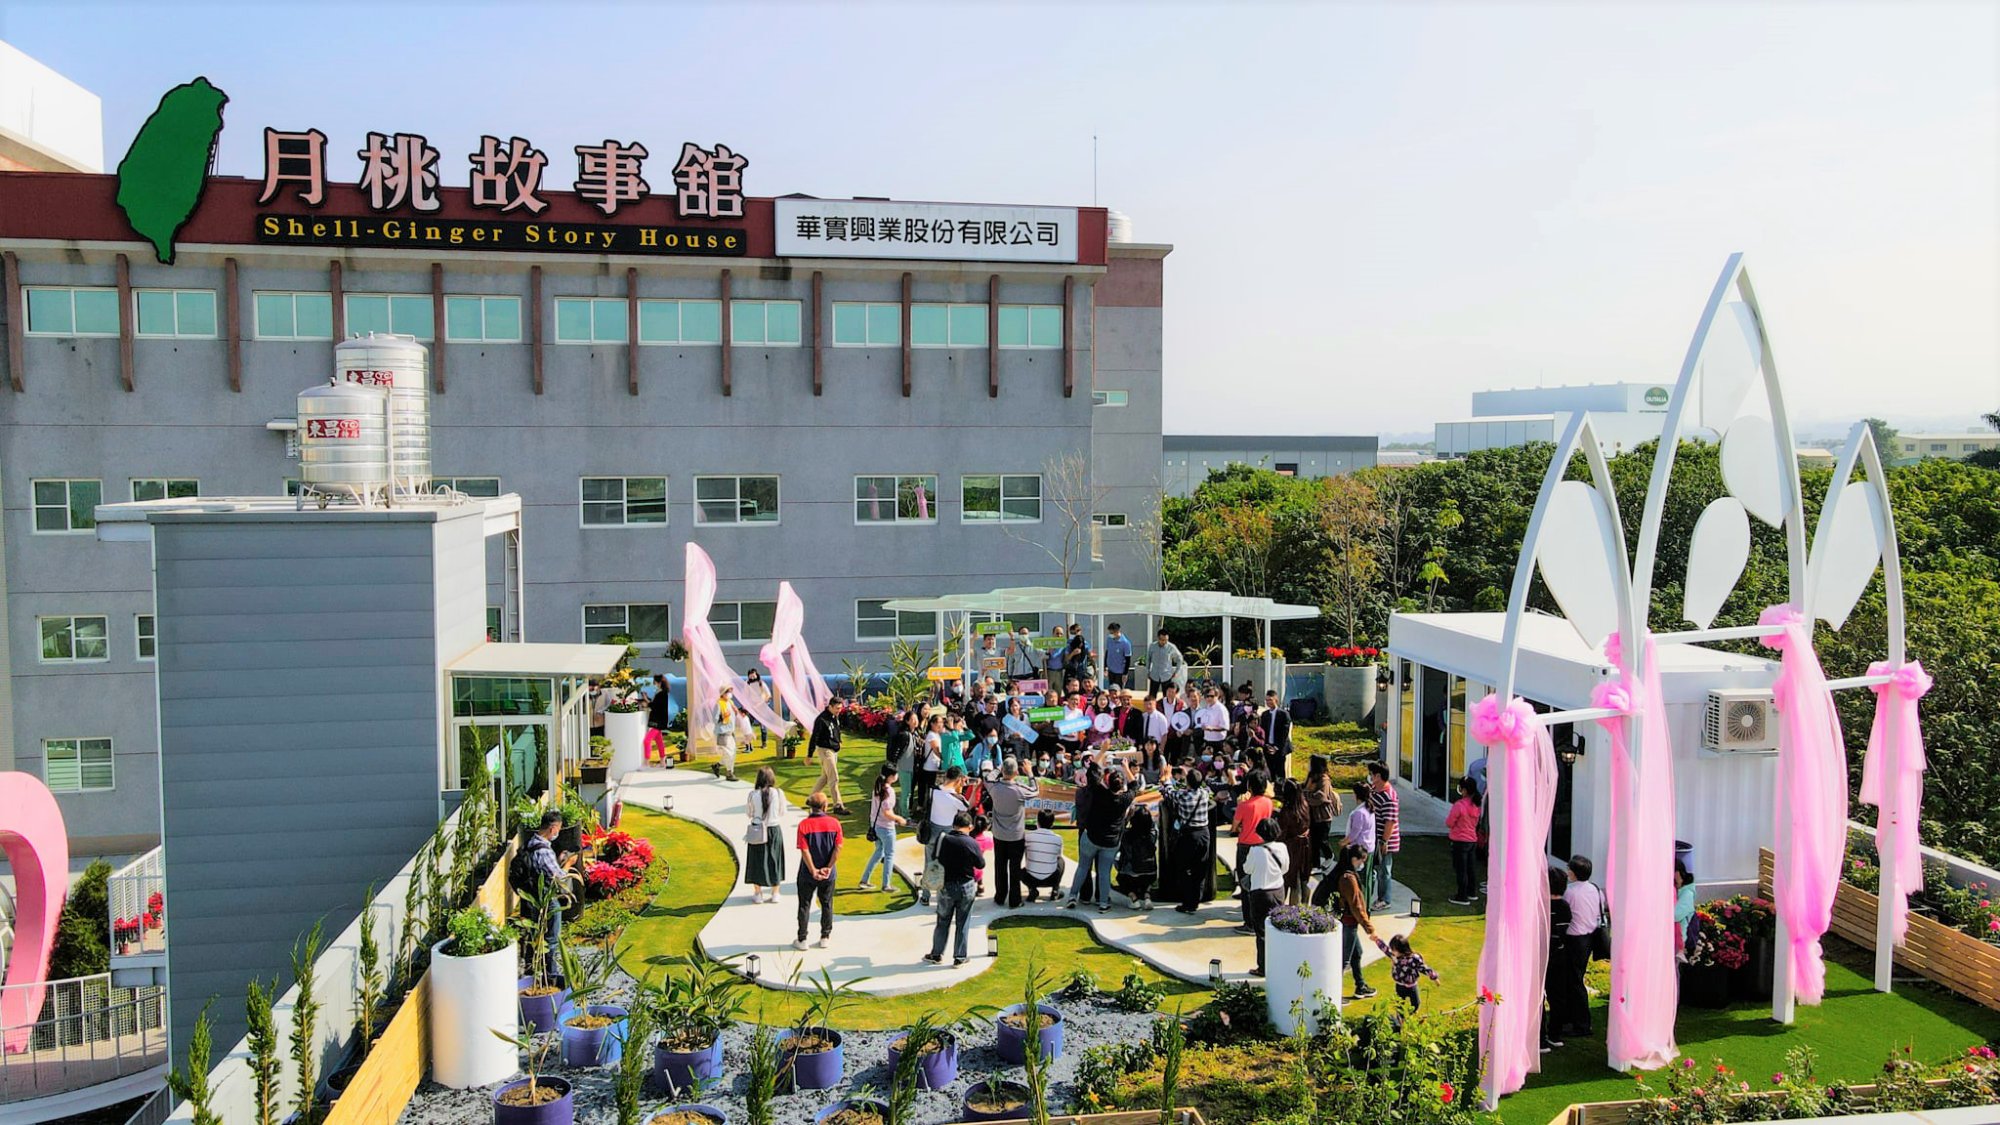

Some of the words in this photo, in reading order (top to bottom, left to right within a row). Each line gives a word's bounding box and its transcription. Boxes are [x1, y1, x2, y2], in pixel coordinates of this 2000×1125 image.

[263, 217, 503, 244] Shell-Ginger
[525, 225, 616, 248] Story
[639, 228, 738, 248] House
[796, 215, 1059, 246] 華實興業股份有限公司
[309, 421, 339, 437] 東昌
